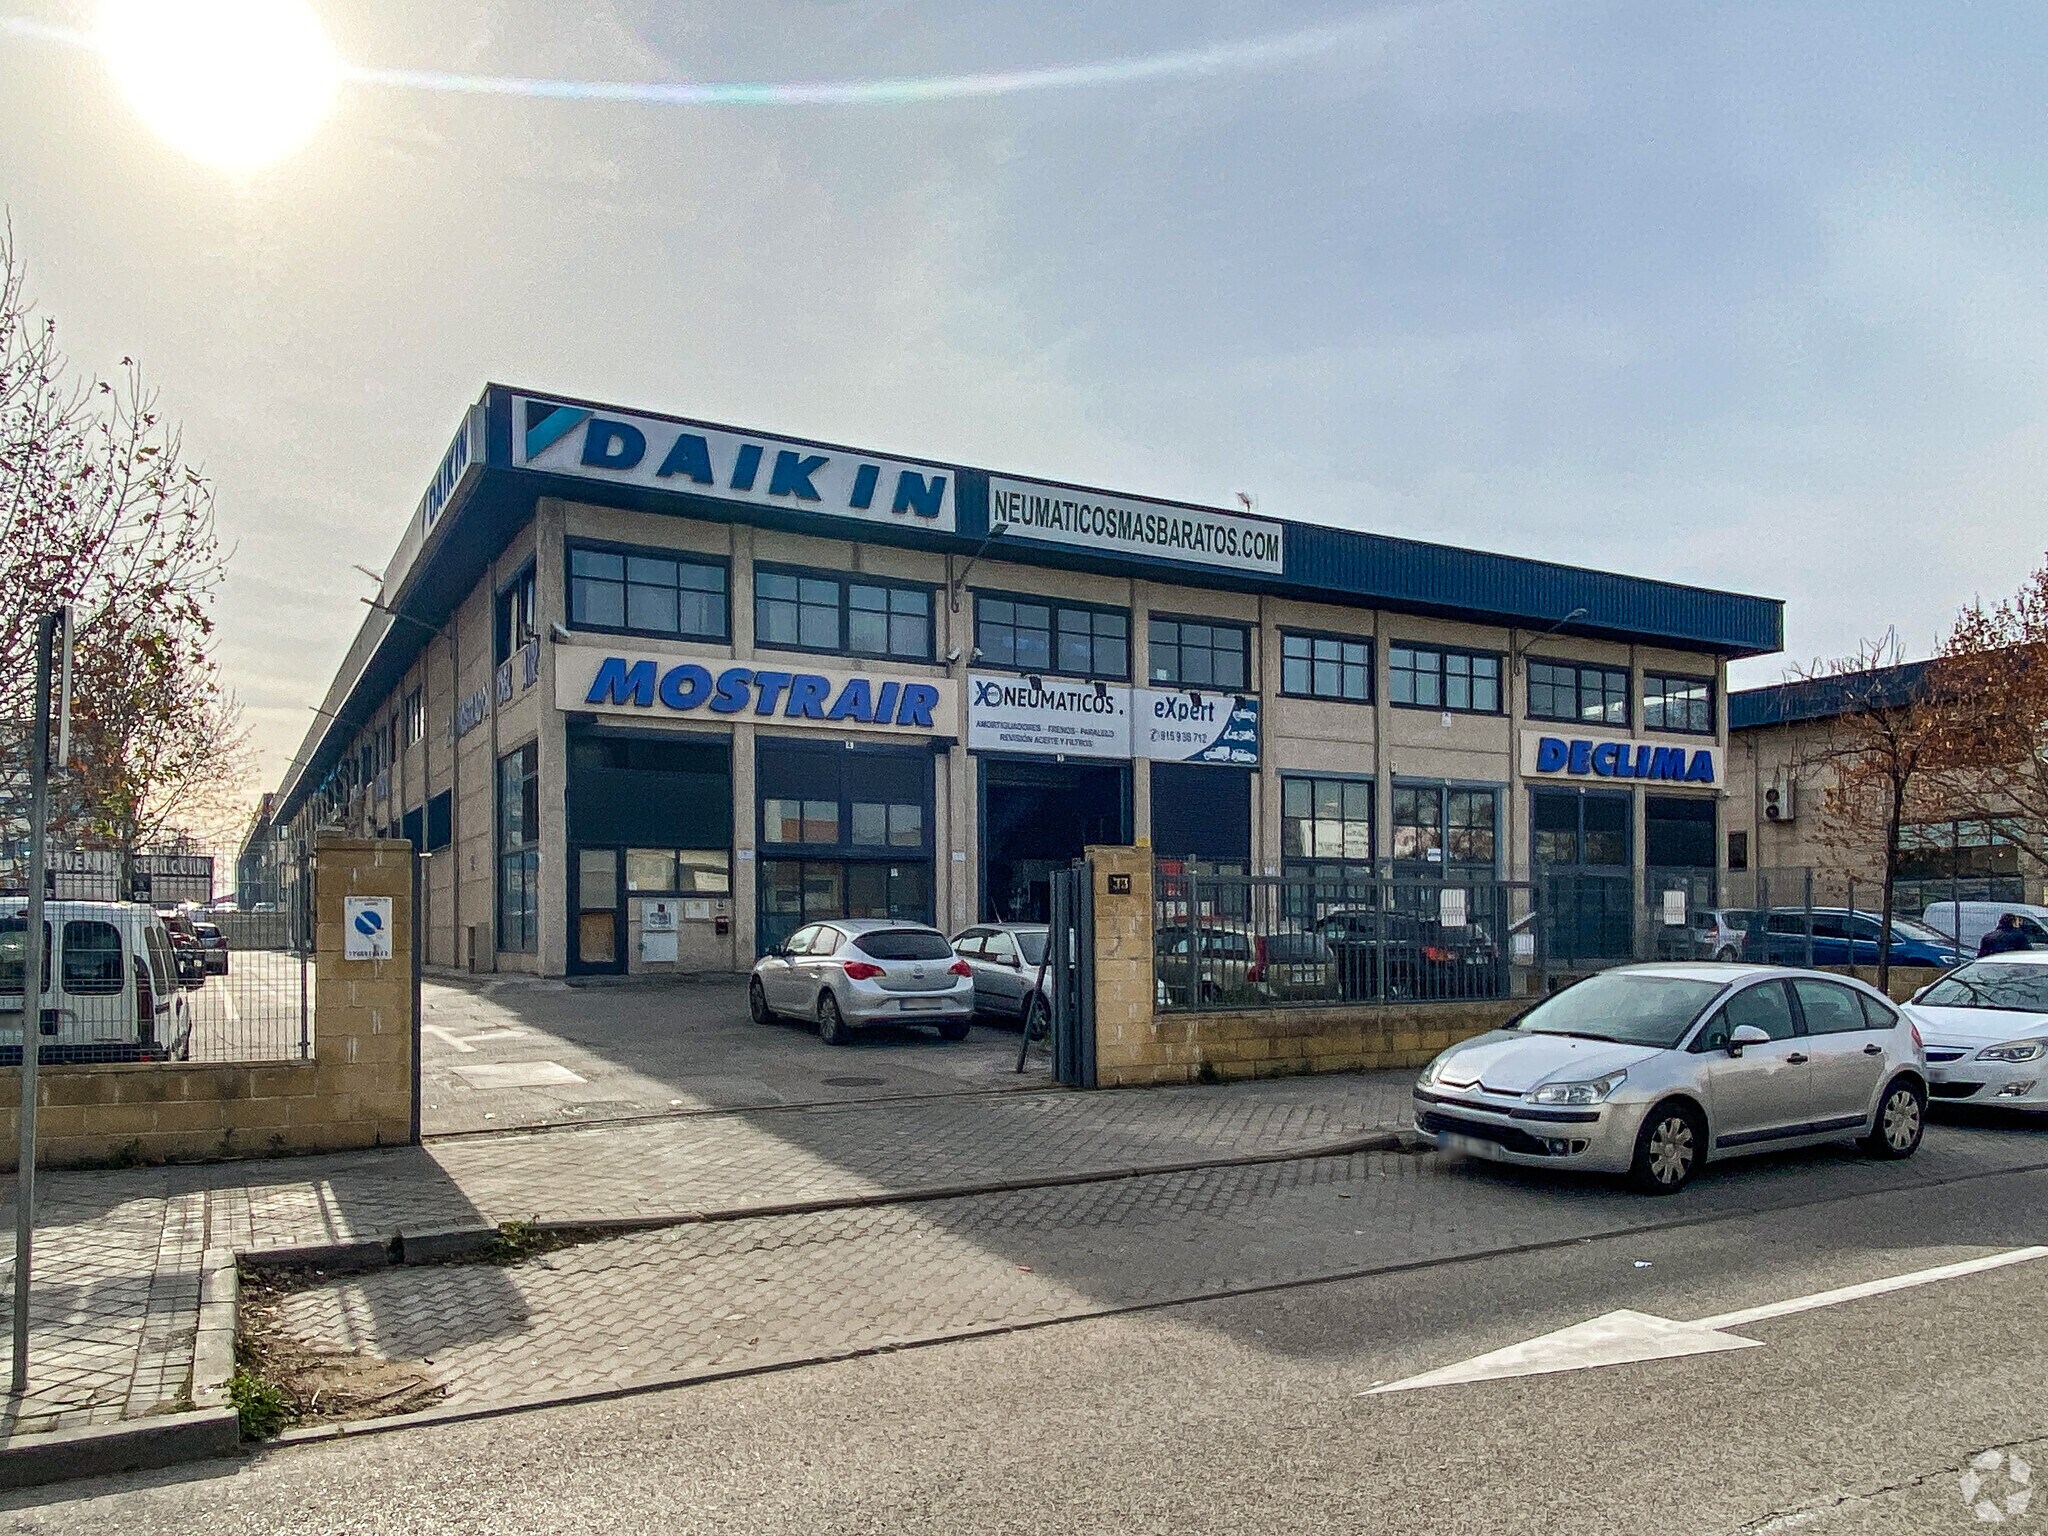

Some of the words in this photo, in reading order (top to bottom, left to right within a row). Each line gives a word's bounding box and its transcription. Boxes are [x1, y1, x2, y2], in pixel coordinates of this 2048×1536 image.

[428, 428, 467, 528] DAIKIN
[581, 419, 946, 518] DAIKIN
[994, 491, 1279, 562] NEUMATICOSMASBARATOS.COM
[586, 657, 939, 728] MOSTRAIR
[1154, 697, 1214, 722] eXpert
[1536, 737, 1715, 783] DECLIMA
